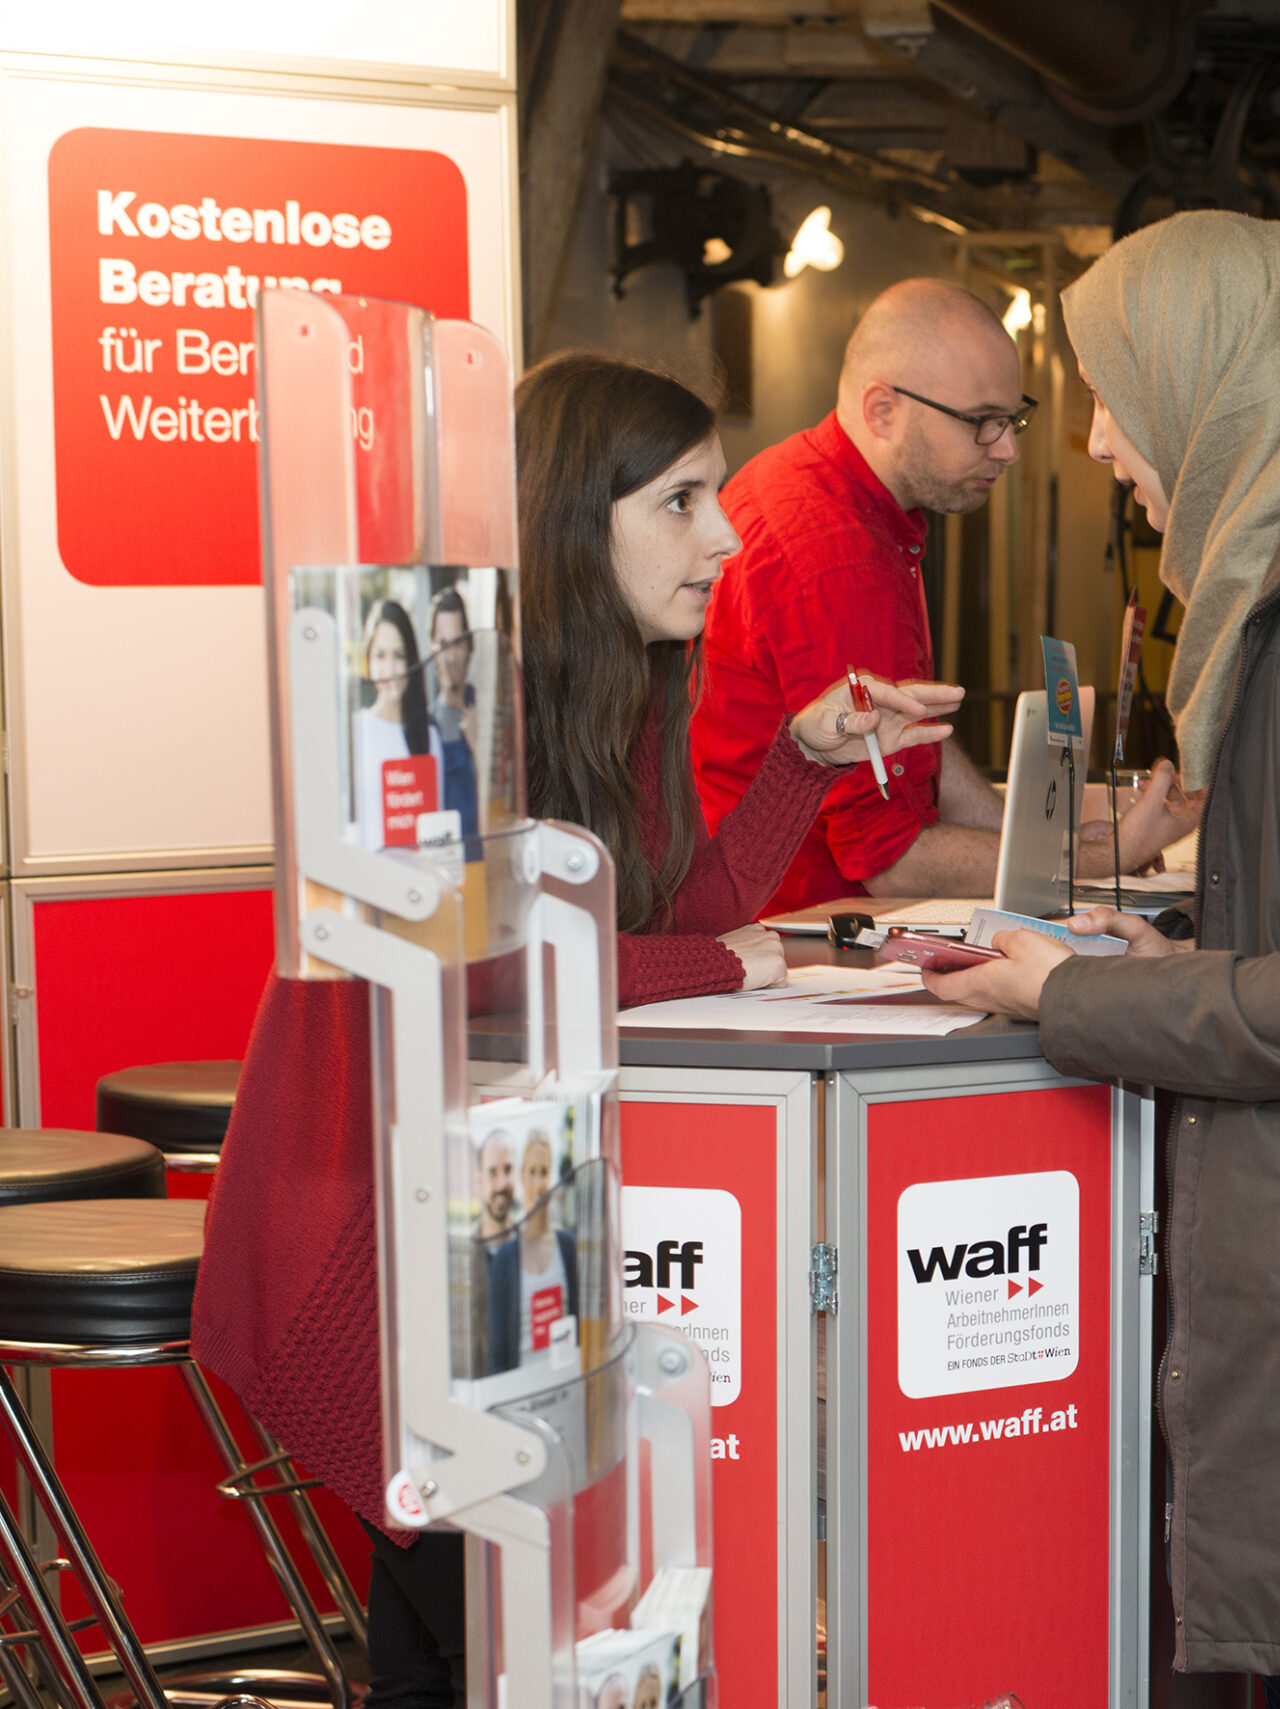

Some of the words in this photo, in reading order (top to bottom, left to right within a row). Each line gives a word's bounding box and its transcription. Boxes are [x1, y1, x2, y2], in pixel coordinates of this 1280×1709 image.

[97, 190, 393, 250] Kostenlose
[99, 327, 163, 373] für
[176, 329, 255, 376] Ber
[624, 1240, 704, 1290] aff
[906, 1223, 1048, 1284] waff
[945, 1287, 999, 1307] Wiener
[947, 1302, 1070, 1329] ArbeitnehmerInnen
[947, 1322, 1070, 1351] Förderungsfonds
[947, 1358, 960, 1371] EIN
[962, 1355, 989, 1369] FONDS
[990, 1353, 1006, 1366] DER
[899, 1403, 1078, 1452] www.waff.at
